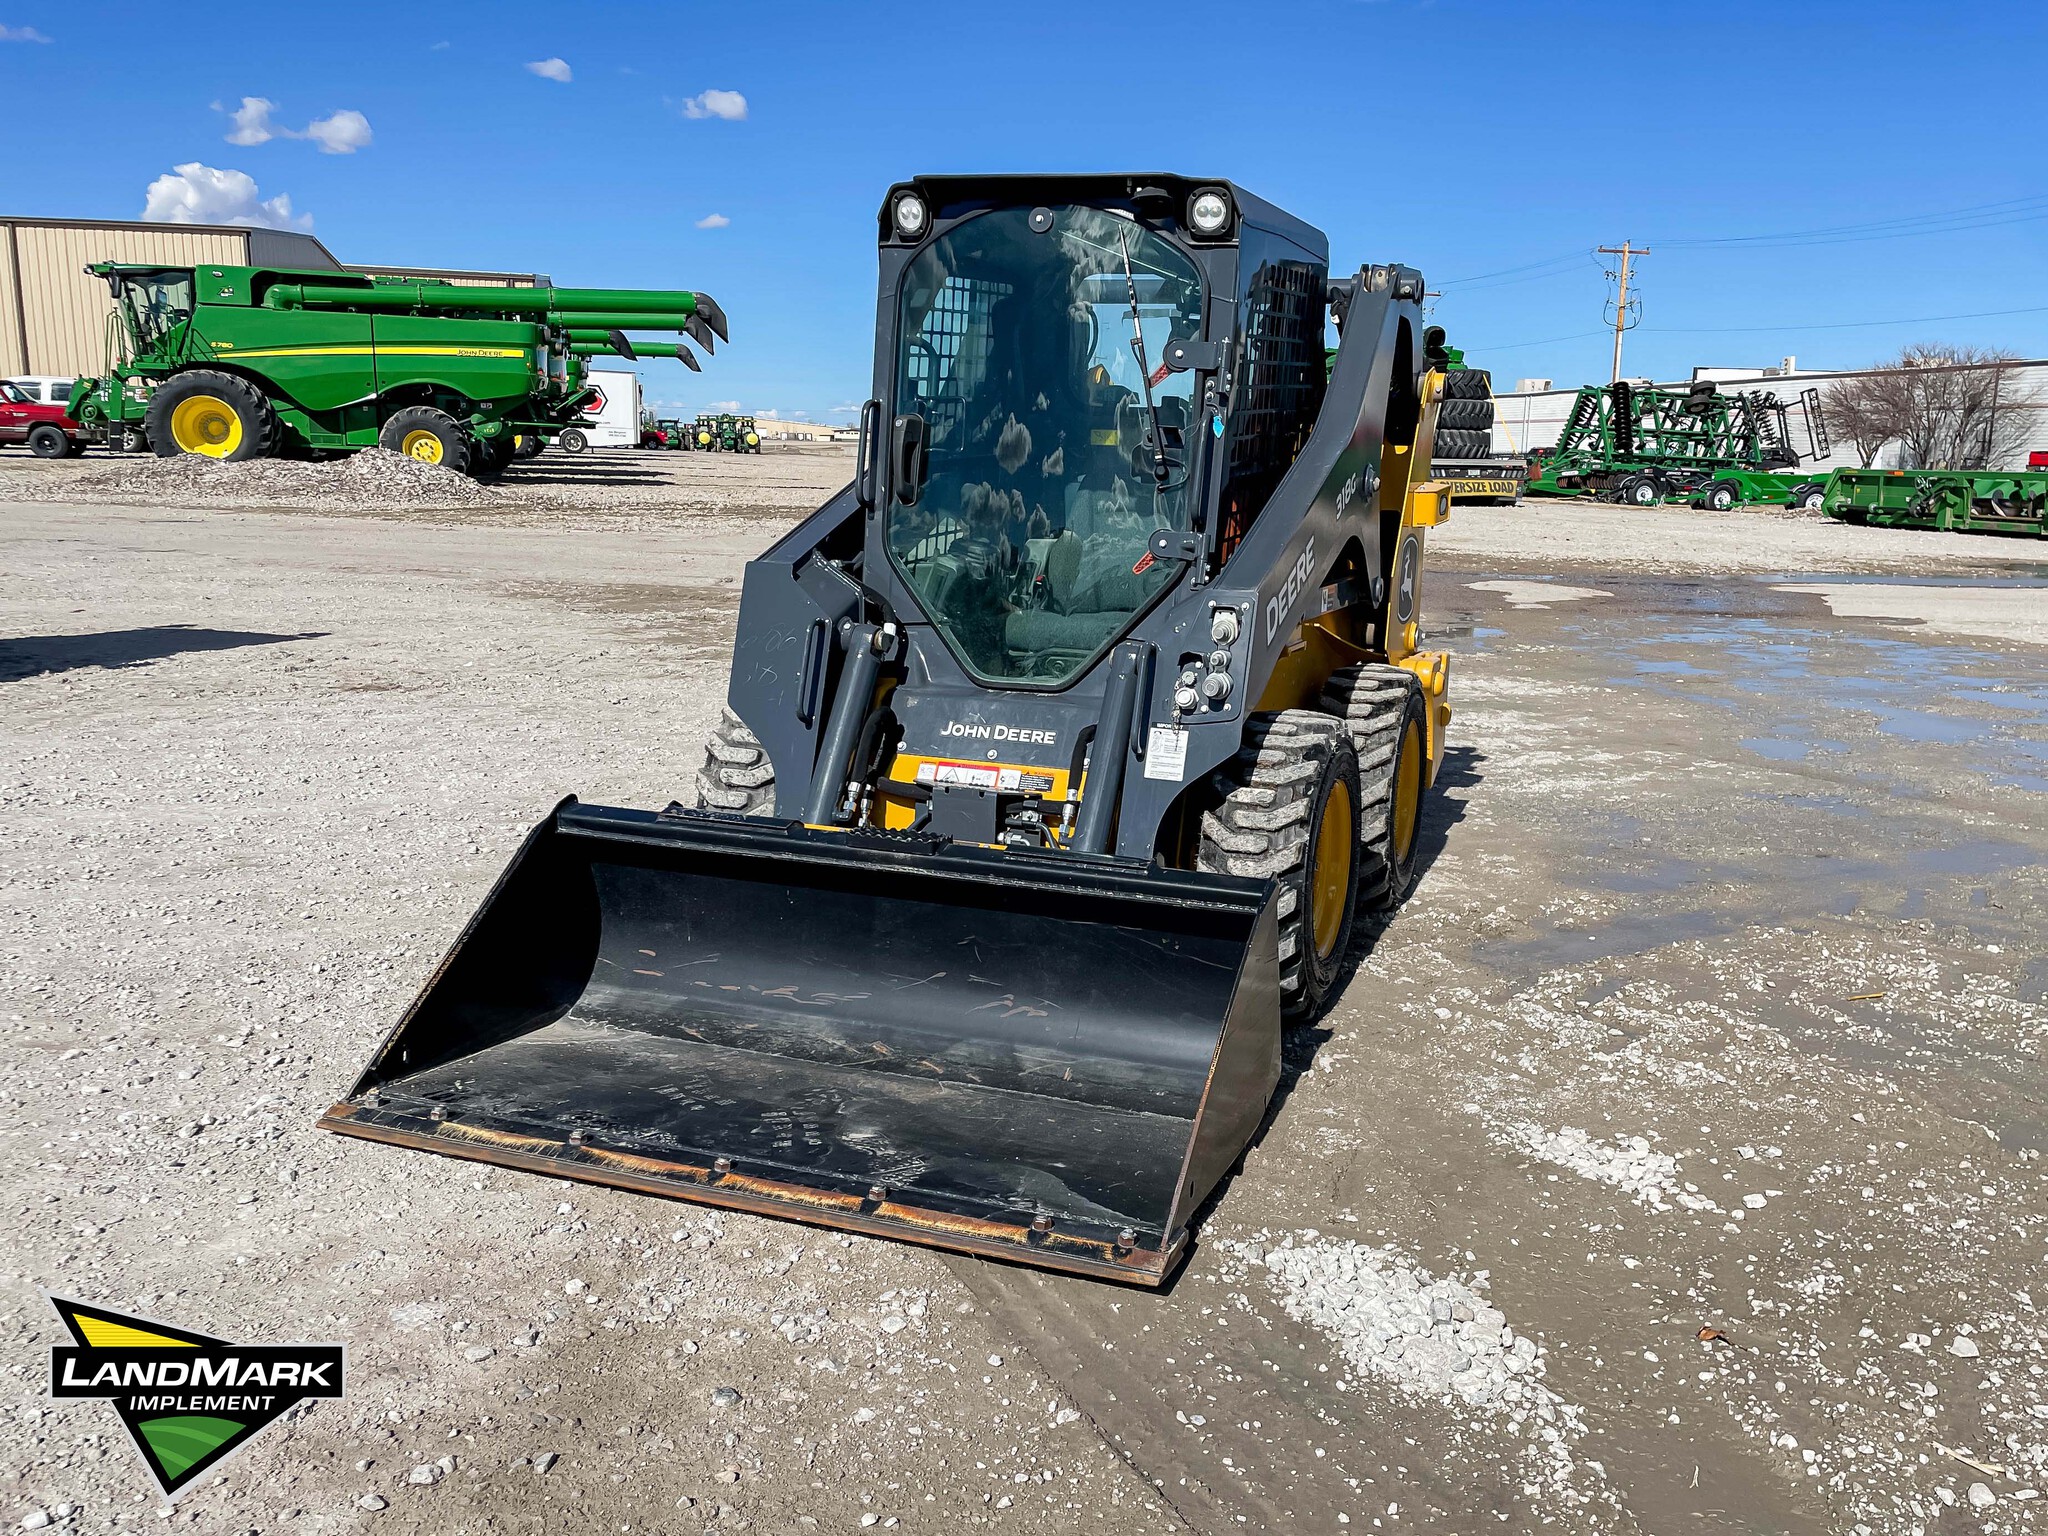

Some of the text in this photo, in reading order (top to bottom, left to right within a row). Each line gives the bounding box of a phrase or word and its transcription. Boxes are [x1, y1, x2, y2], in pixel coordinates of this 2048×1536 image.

[478, 349, 503, 357] DEERE
[1335, 472, 1357, 520] 318G
[1488, 481, 1514, 494] LOAD
[1266, 535, 1316, 647] DEERE
[940, 720, 1057, 745] JOHN DEERE
